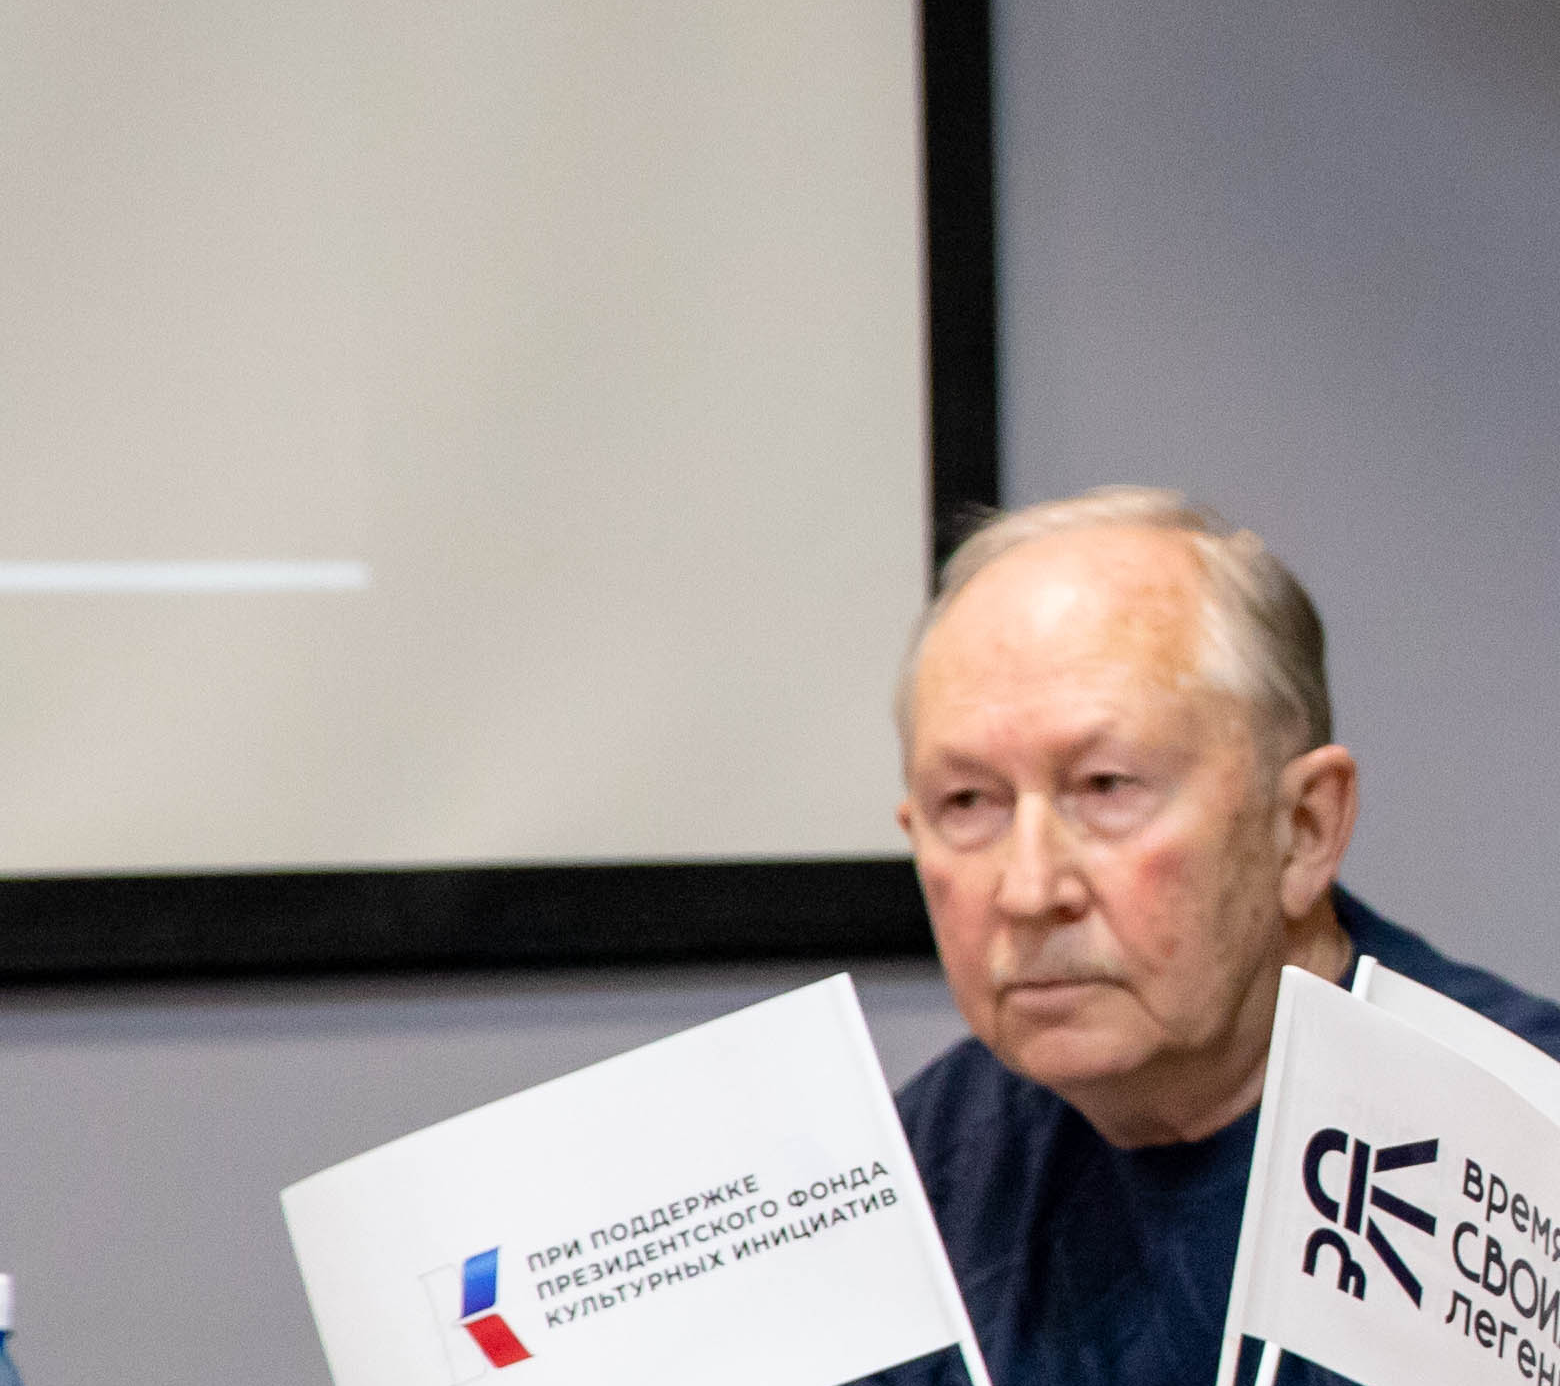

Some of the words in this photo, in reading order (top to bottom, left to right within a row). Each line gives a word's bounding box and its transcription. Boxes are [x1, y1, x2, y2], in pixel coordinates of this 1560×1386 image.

[526, 1239, 583, 1273] ПРИ
[589, 1173, 761, 1251] ПОДДЕРЖКЕ
[536, 1199, 779, 1301] ПРЕЗИДЕНТСКОГО
[787, 1160, 890, 1209] ФОНДА
[544, 1250, 726, 1328] КУЛЬТУРНЫХ
[732, 1186, 899, 1262] ИНИЦИАТИВ
